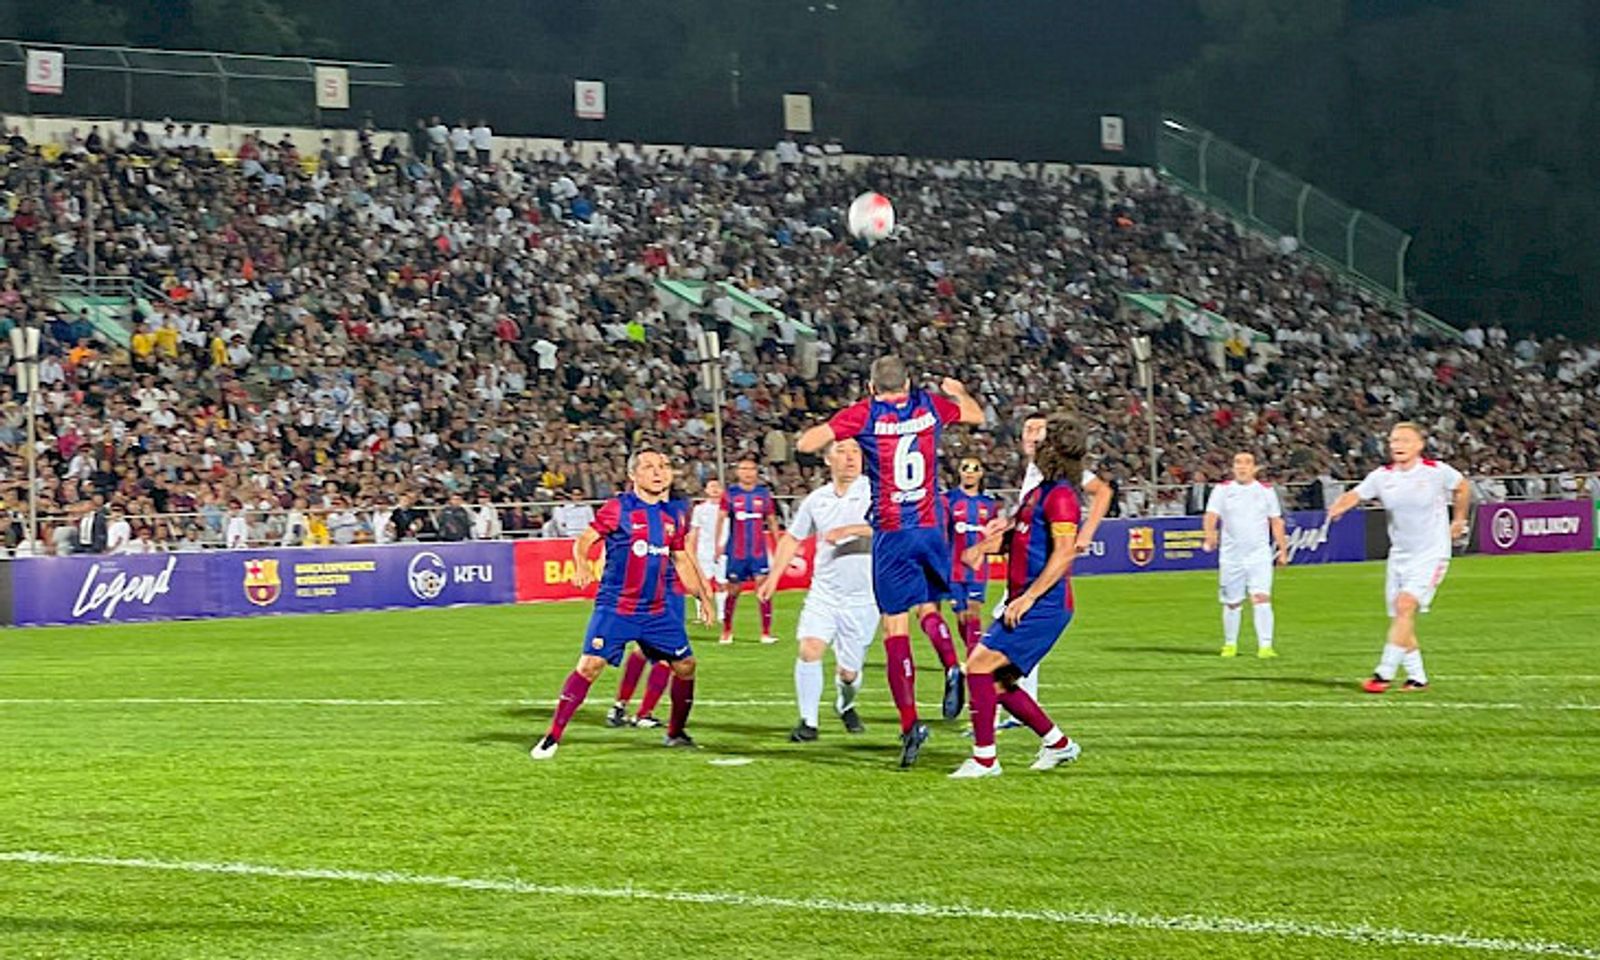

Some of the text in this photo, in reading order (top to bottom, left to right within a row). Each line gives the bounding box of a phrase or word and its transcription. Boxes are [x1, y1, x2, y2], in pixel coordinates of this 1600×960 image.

[38, 59, 52, 80] 5
[893, 434, 926, 491] 6
[72, 556, 177, 618] Legend
[453, 565, 492, 583] KFU
